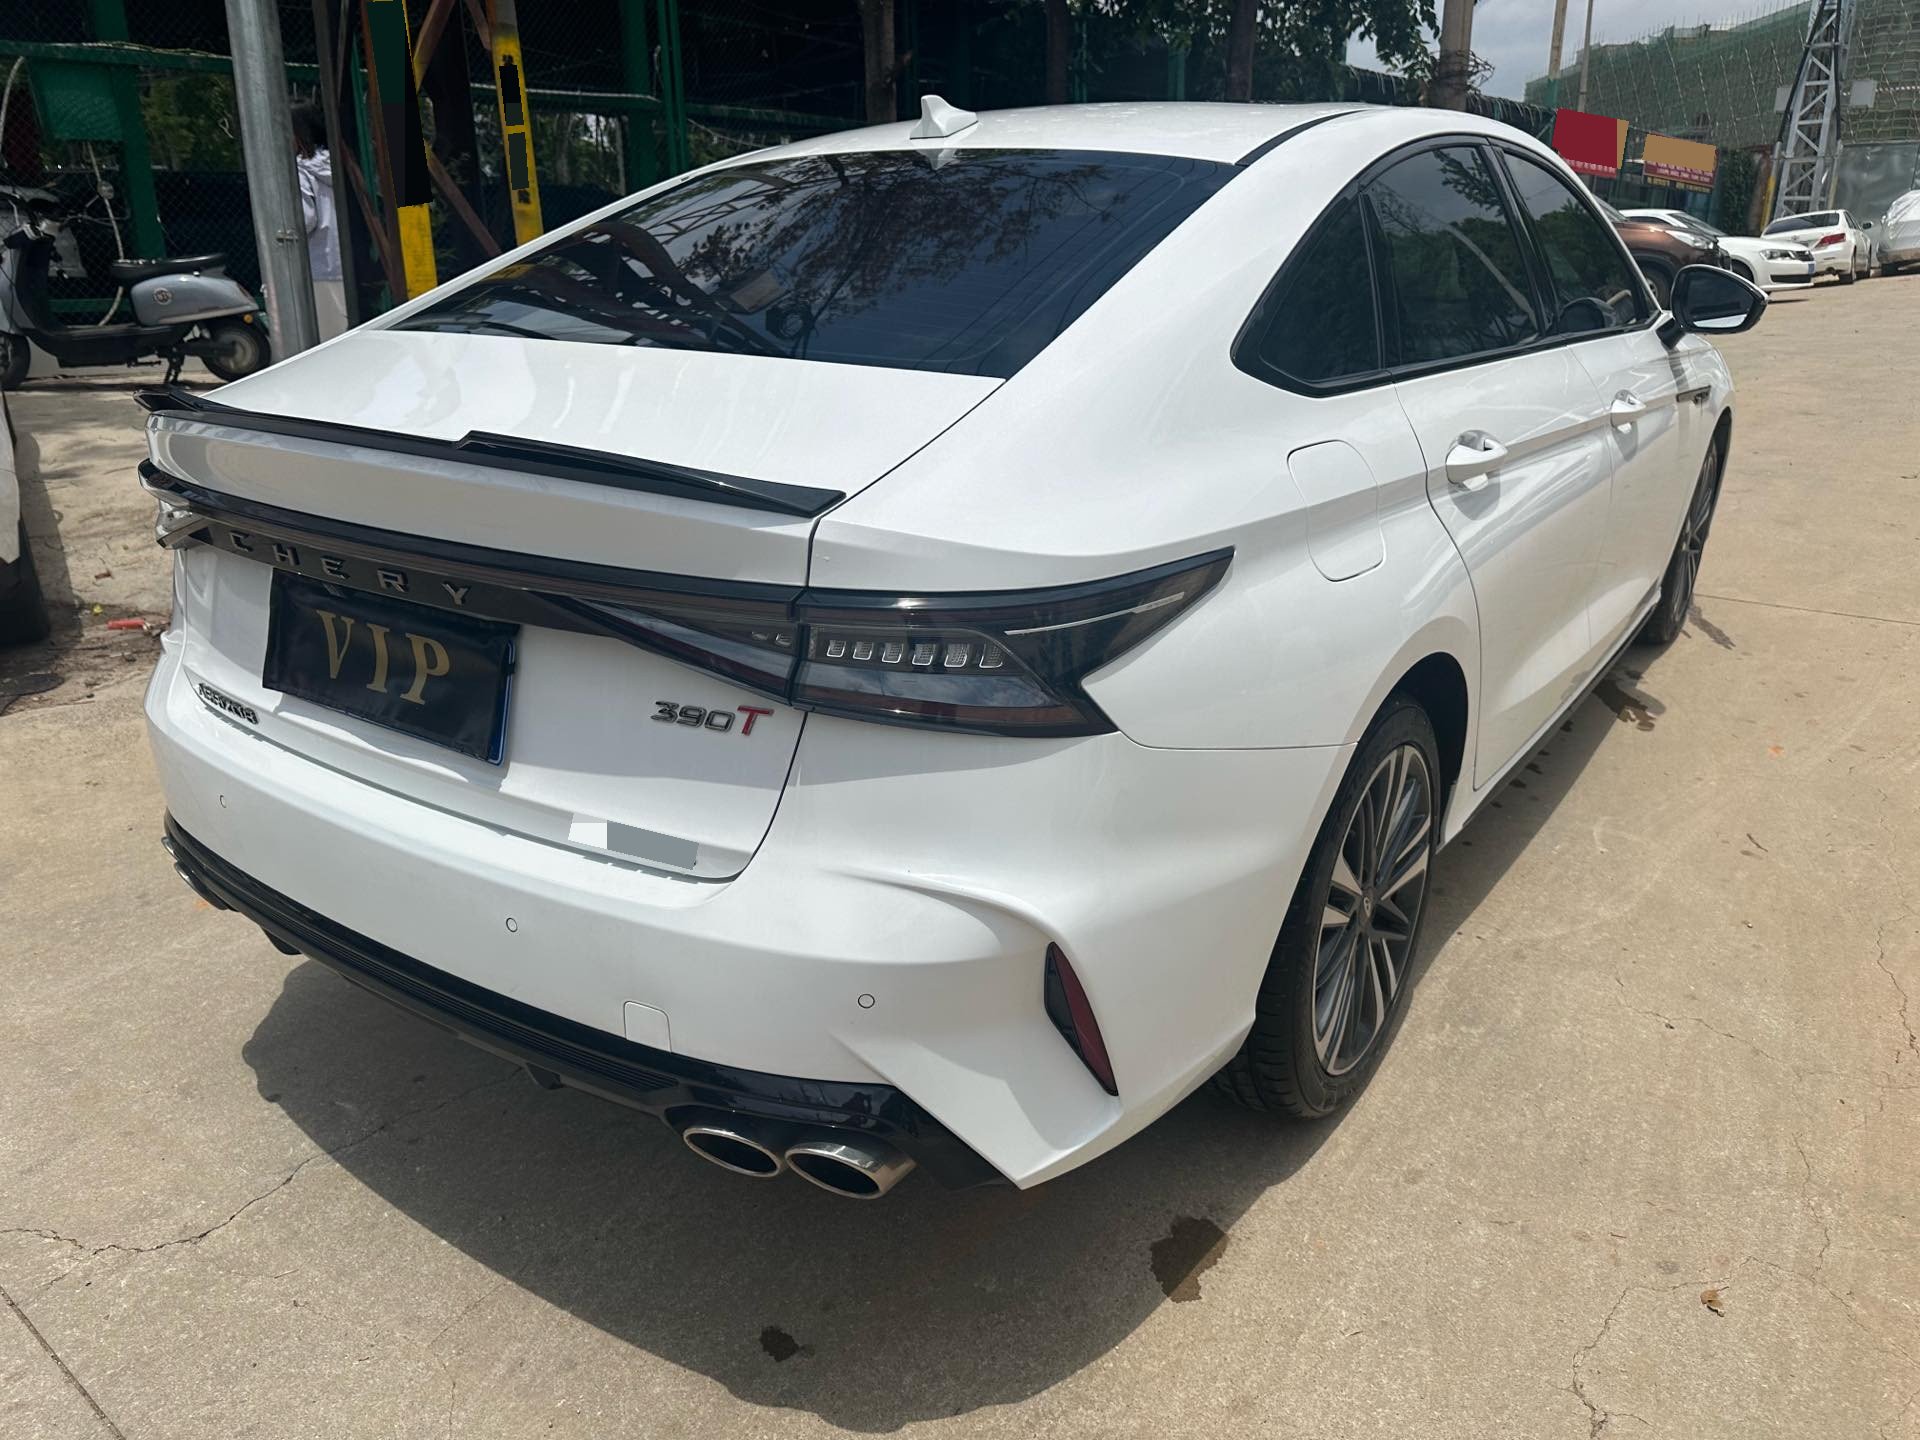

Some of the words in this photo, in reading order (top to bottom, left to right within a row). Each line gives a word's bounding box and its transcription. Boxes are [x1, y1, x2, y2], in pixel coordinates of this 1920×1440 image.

[230, 531, 471, 606] CHERY
[315, 609, 450, 706] VIP
[650, 700, 775, 737] 390T
